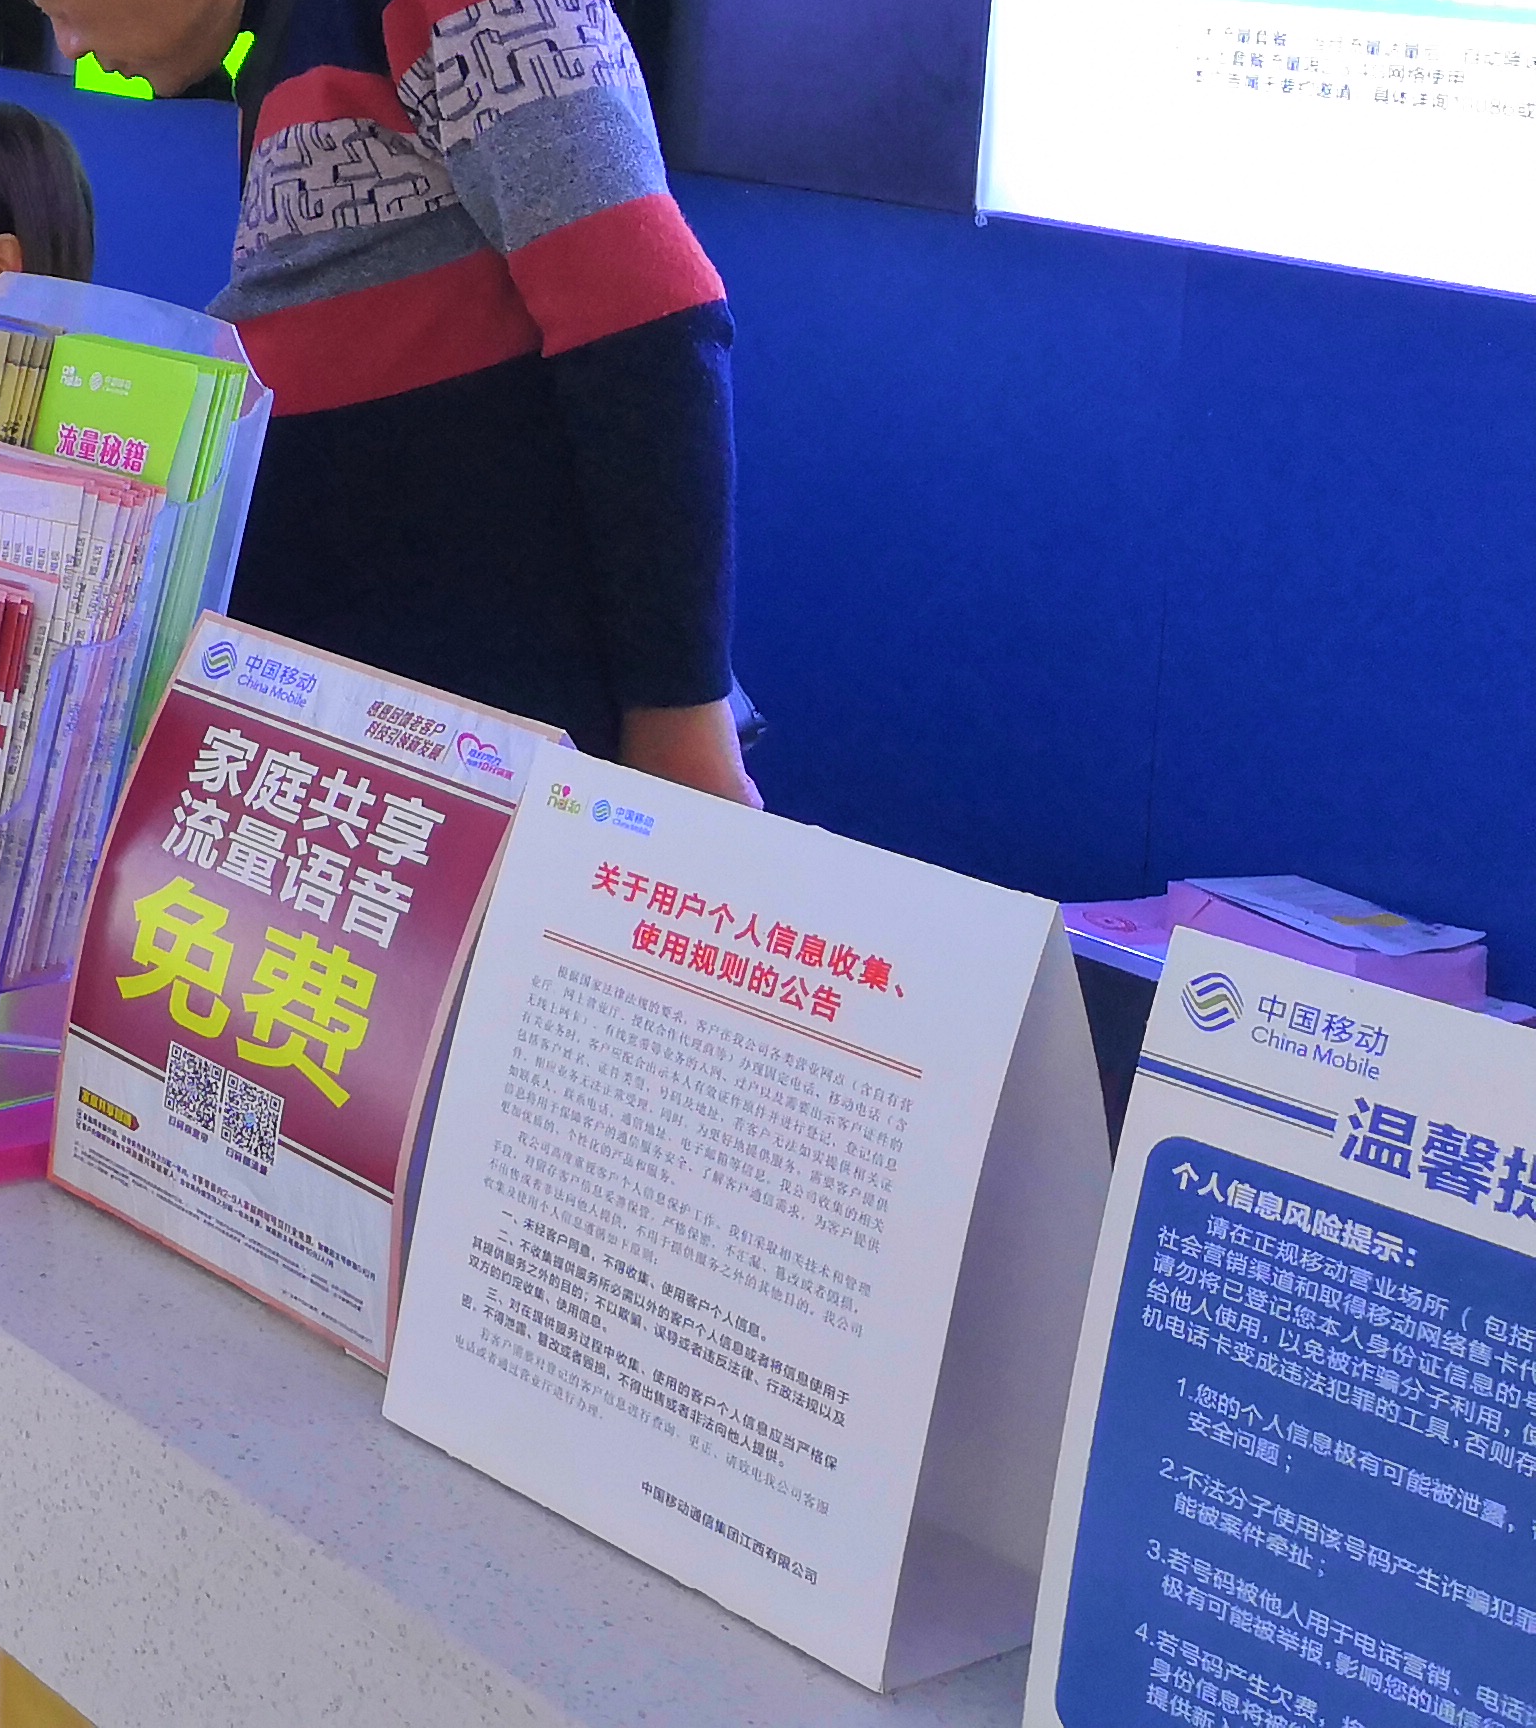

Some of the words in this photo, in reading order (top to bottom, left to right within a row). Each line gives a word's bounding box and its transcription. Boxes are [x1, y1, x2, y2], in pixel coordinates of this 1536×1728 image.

[55, 422, 150, 475] 流量秘籍
[236, 672, 270, 698] China
[269, 684, 310, 711] Mobile
[243, 651, 319, 696] 中国移动
[186, 722, 447, 868] 家庭共享
[159, 788, 412, 949] 流量语音
[590, 859, 906, 1000] 关于用户个人信息收集、
[632, 917, 843, 1024] 使用规则的公告
[115, 874, 379, 1109] 免费
[1257, 994, 1390, 1058] 中国移动
[1250, 1025, 1308, 1059] China
[1312, 1042, 1382, 1081] Mobile
[1171, 1161, 1418, 1268] 个人信息风险提示：
[1176, 1375, 1536, 1540] 1.您的个人信息极有可能被泄露，
[1187, 1410, 1294, 1474] 安全问题；
[640, 1479, 819, 1586] 中国移动通信集团江西有限公司
[1173, 1491, 1329, 1578] 能被案件牵扯；
